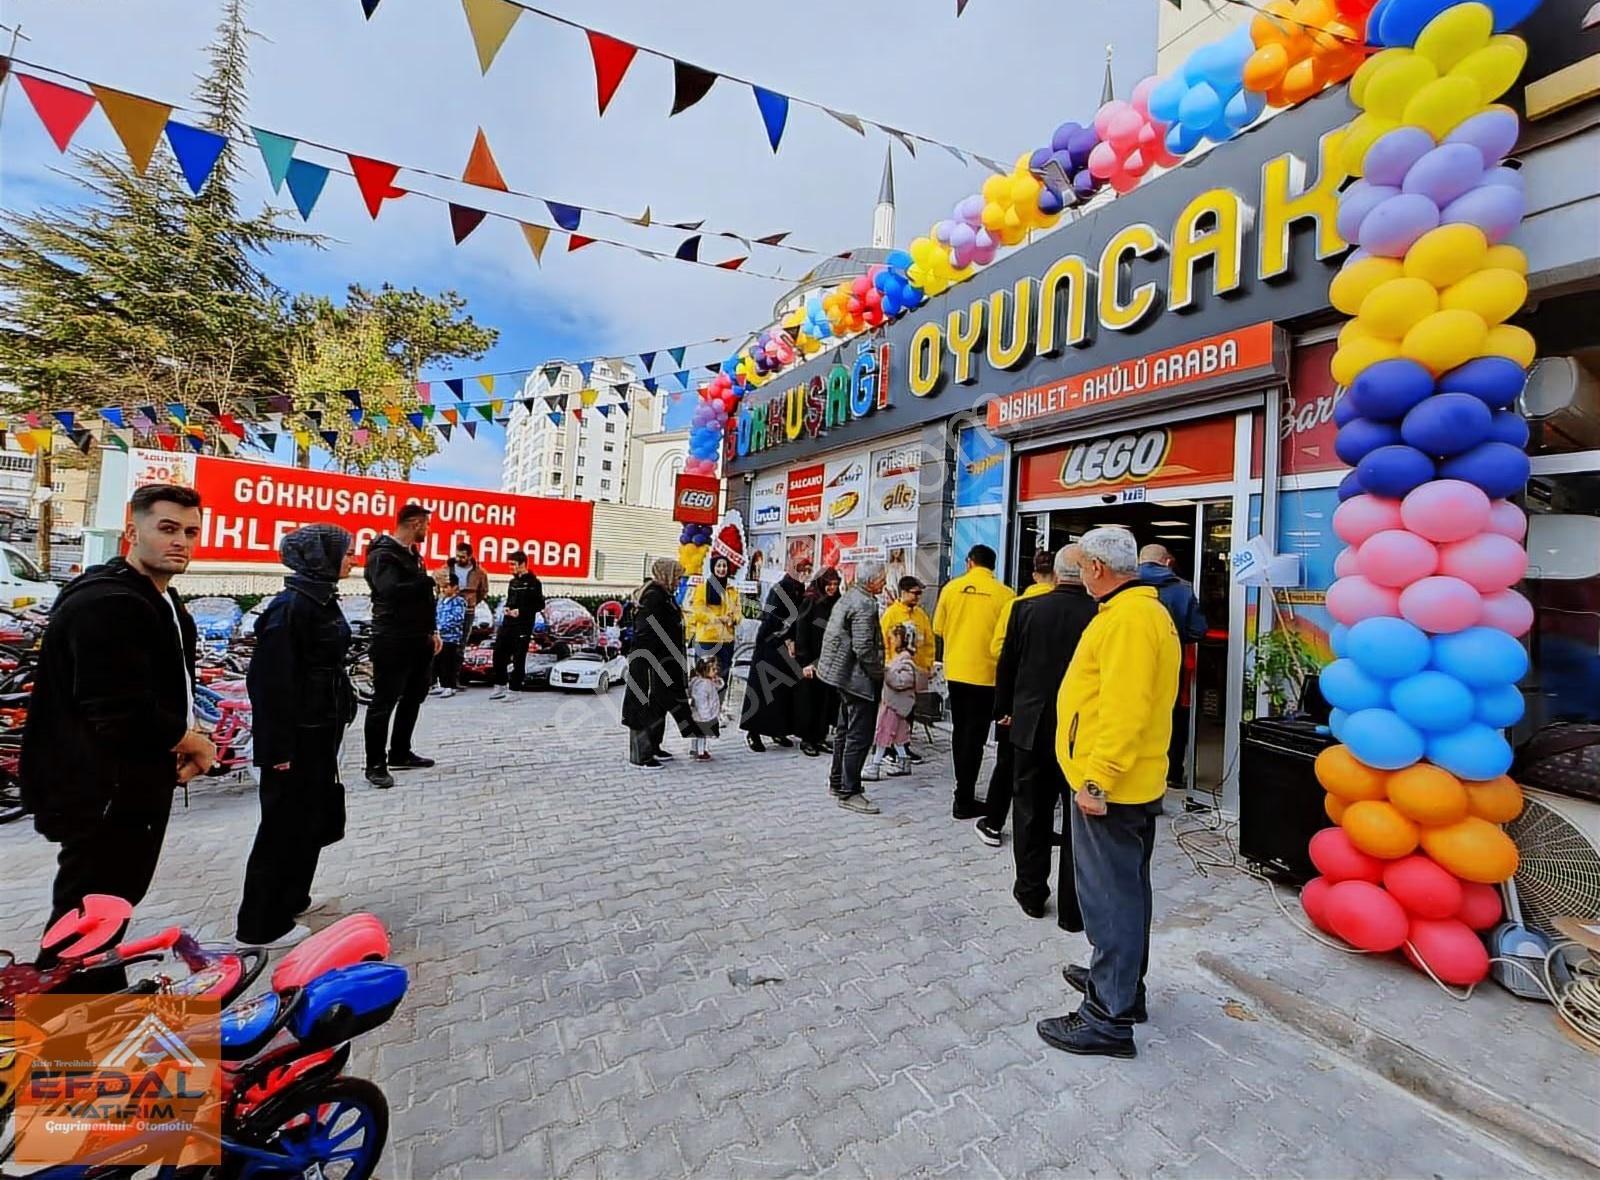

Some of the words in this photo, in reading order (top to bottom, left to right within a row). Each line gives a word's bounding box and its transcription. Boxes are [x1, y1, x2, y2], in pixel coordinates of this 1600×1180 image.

[723, 338, 891, 462] GÖKKUŞAĞI
[909, 128, 1350, 398] OYUNCAK
[999, 385, 1069, 422] BİSİKLET
[1082, 359, 1149, 403] AKÜLÜ
[1153, 339, 1237, 385] ARABA
[1280, 384, 1348, 440] Bar
[790, 475, 822, 490] SALCANO
[1062, 430, 1168, 487] LEGO
[233, 476, 396, 517] GÖKKUŞAĞI
[405, 497, 517, 527] YUNCAK
[680, 491, 714, 508] LEGO
